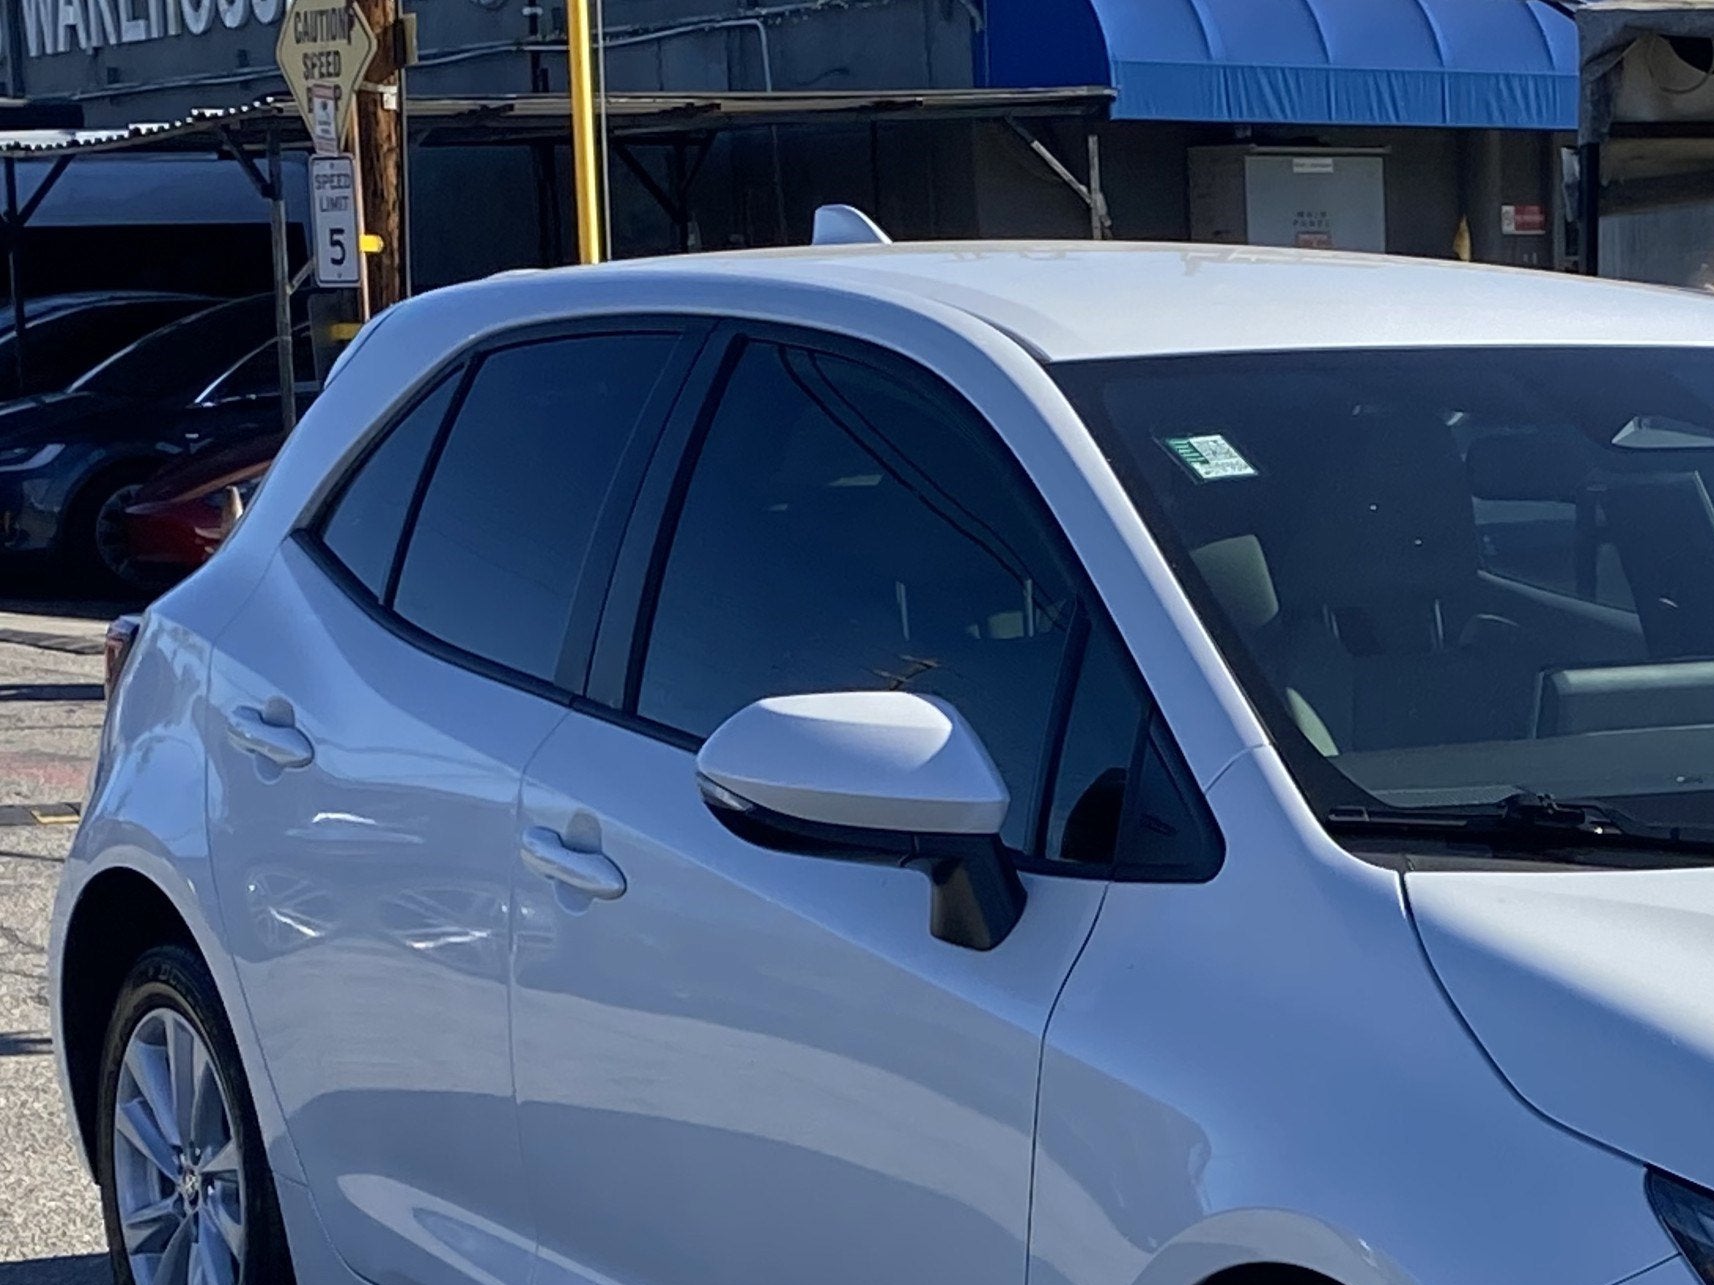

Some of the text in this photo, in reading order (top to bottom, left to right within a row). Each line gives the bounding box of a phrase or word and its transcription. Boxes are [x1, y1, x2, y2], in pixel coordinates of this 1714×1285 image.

[294, 7, 352, 44] CAUTION
[302, 50, 340, 80] SPEED
[314, 173, 350, 190] SPEED
[319, 195, 348, 212] LIMIT
[329, 227, 345, 266] 5
